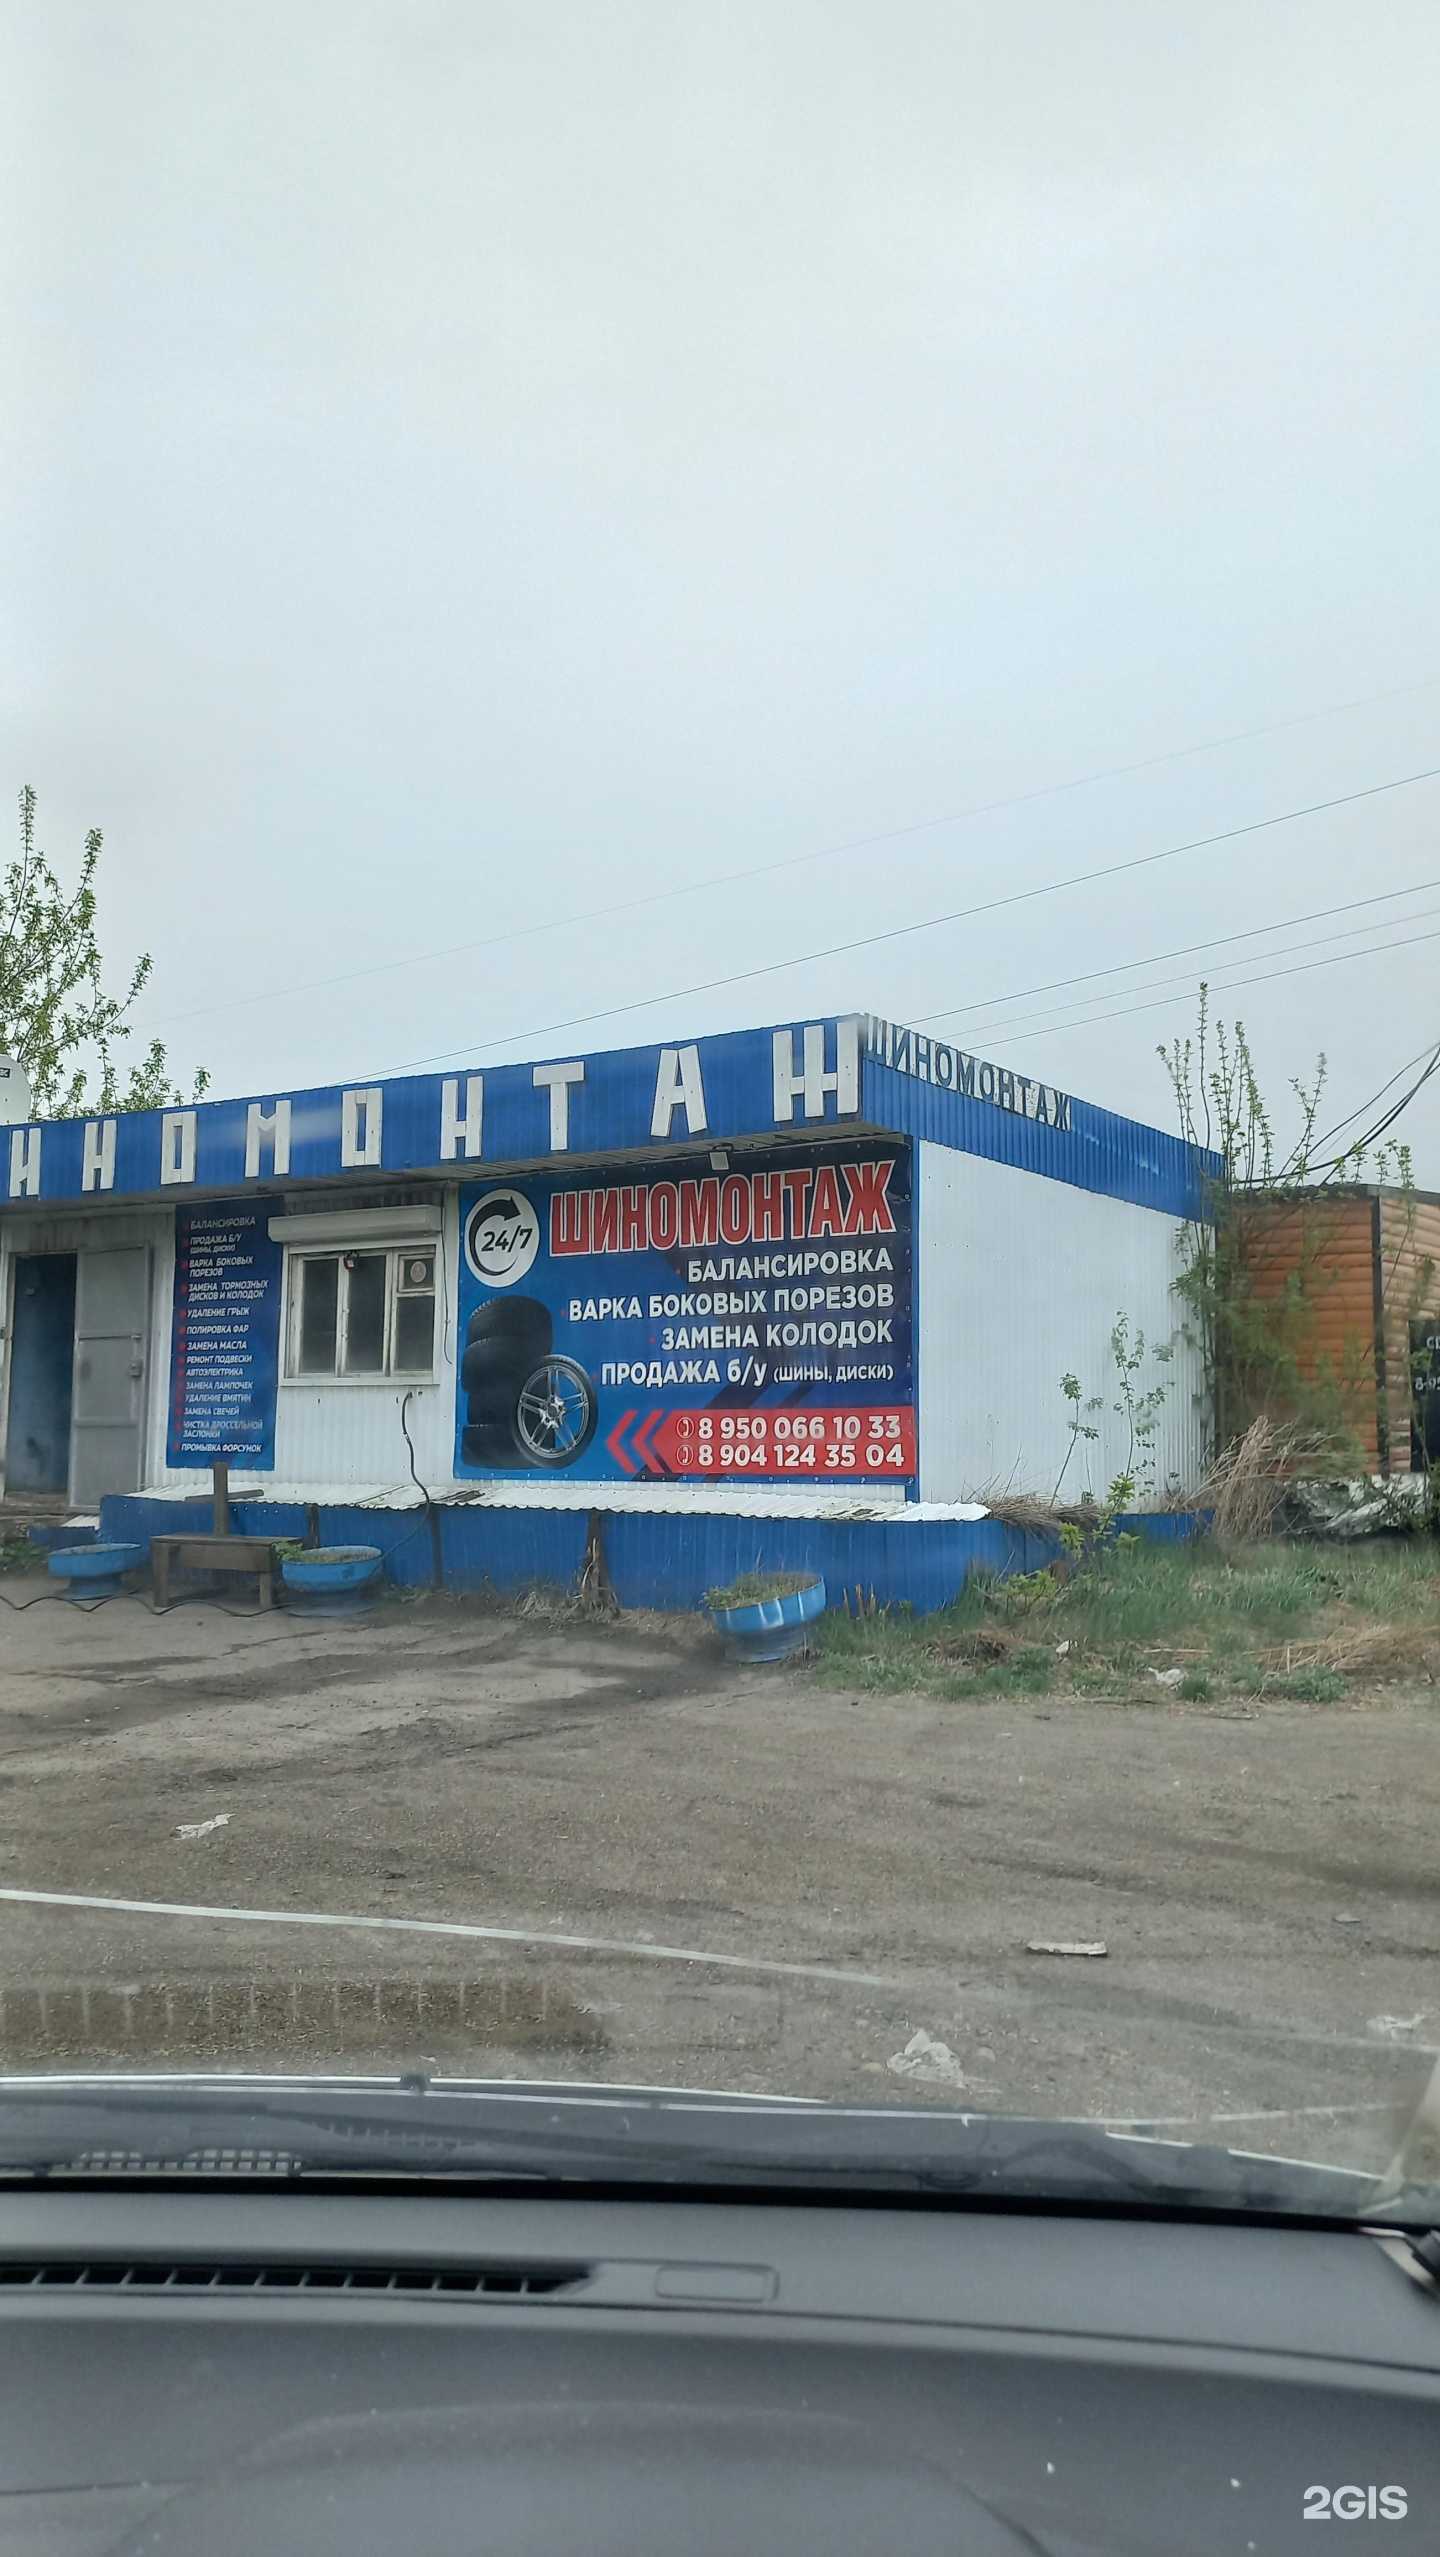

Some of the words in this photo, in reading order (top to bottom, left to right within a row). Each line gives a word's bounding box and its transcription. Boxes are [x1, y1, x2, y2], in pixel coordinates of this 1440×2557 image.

[864, 1014, 1072, 1131] ШИНОМОНТАЖ
[549, 1159, 896, 1257] ШИНОМОНТАЖ
[191, 1217, 256, 1229] БАЛАНСИРОВКА
[190, 1235, 227, 1245] ПРОДАЖА
[481, 1227, 533, 1252] 24/7
[189, 1259, 213, 1268] ВАРКА
[216, 1256, 253, 1266] БОКОВЫХ
[688, 1247, 893, 1283] БАЛАНСИРОВКА
[190, 1268, 223, 1277] ПОРЕЗОВ
[188, 1283, 218, 1292] ЗАМЕНА
[221, 1280, 268, 1289] ТОРМОЗНЫХ
[188, 1292, 218, 1302] ДИСКОВ
[227, 1290, 265, 1299] КОЛОДОК
[568, 1294, 642, 1322] ВАРКА
[649, 1290, 768, 1318] БОКОВЫХ
[773, 1284, 894, 1313] ПОРЕЗОВ
[187, 1308, 226, 1318] УДАЛЕНИЕ
[227, 1307, 250, 1316] ГРЫЖ
[186, 1326, 231, 1335] ПОЛИРОВКА
[233, 1325, 249, 1333] ФАР
[662, 1324, 759, 1351] ЗАМЕНА
[766, 1319, 893, 1349] КОЛОДОК
[187, 1342, 218, 1351] ЗАМЕНА
[220, 1341, 247, 1350] МАСЛА
[186, 1356, 213, 1364] РЕМОНТ
[215, 1355, 252, 1364] ПОДВЕСКИ
[186, 1368, 243, 1377] АВТОЭЛЕКТРИКА
[601, 1359, 720, 1387] ПРОДАЖА
[727, 1356, 767, 1387] б/у
[186, 1382, 213, 1390] ЗАМЕНА
[698, 1418, 714, 1440] 8
[720, 1418, 768, 1440] 950
[774, 1417, 825, 1440] 066
[834, 1417, 862, 1438] 10
[868, 1416, 901, 1438] 33
[181, 1444, 221, 1452] ПРОМЫВКА
[222, 1444, 262, 1453] ФОРСУНОК
[698, 1444, 714, 1465] 8
[720, 1444, 767, 1466] 904
[773, 1444, 816, 1466] 124
[825, 1444, 856, 1466] 35
[867, 1444, 904, 1466] 04
